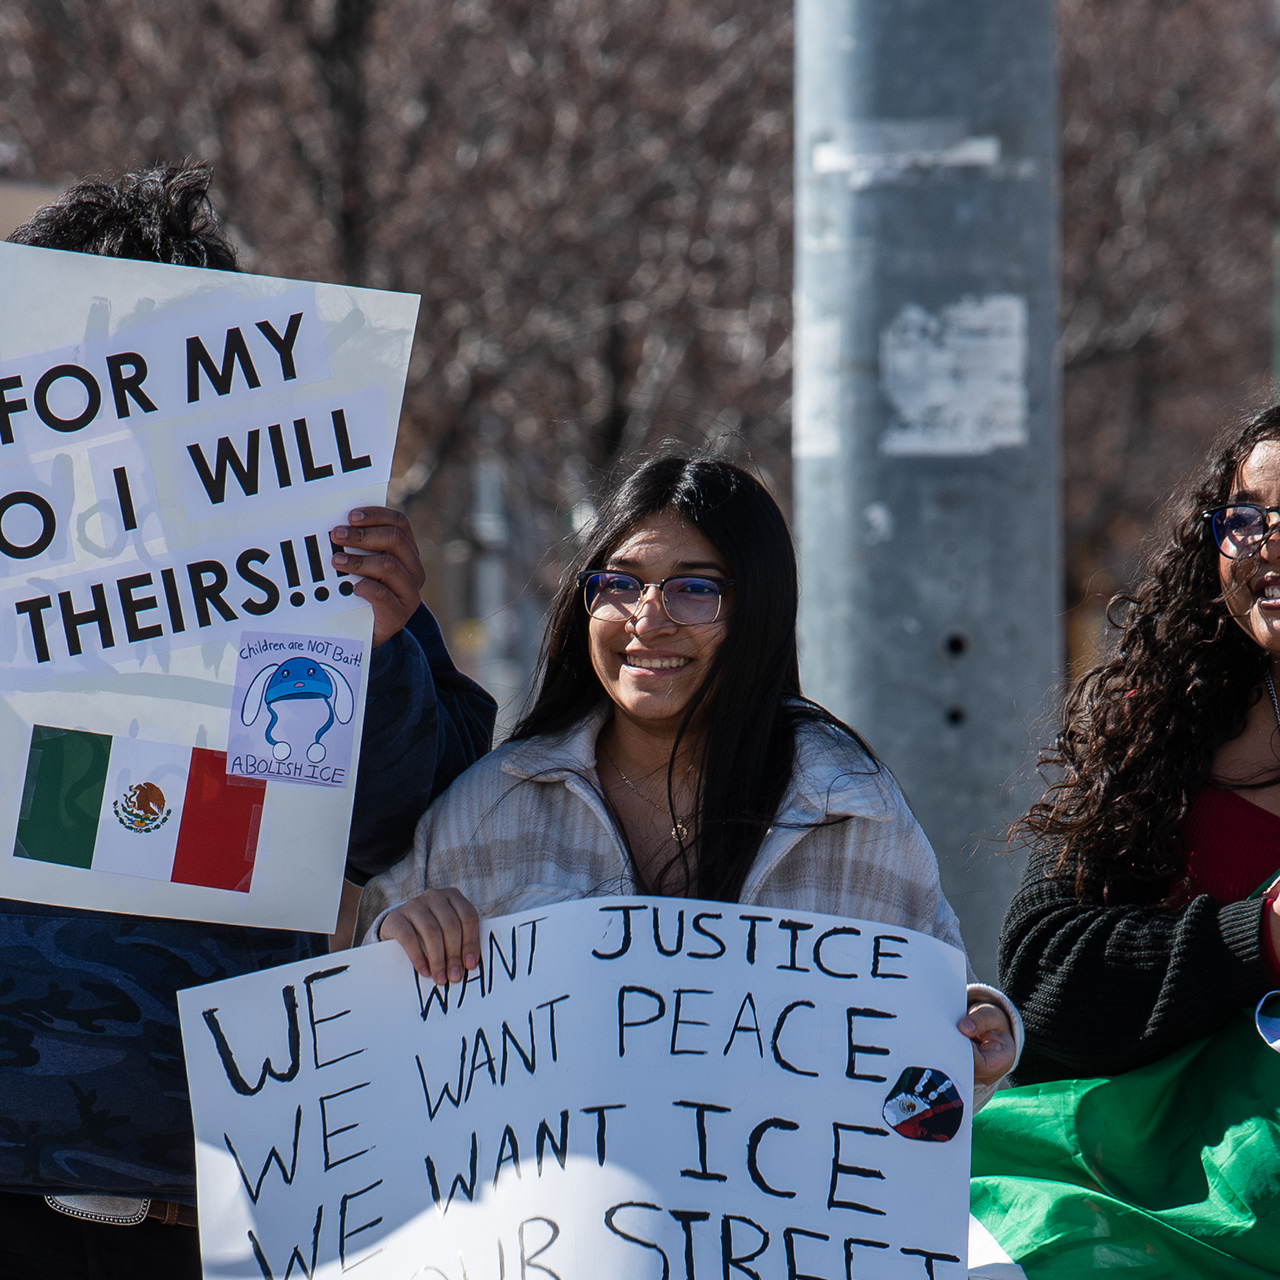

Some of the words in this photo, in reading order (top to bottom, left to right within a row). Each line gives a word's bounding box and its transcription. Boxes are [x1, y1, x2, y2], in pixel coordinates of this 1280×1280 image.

[186, 312, 304, 404] MY
[112, 466, 138, 532] I
[186, 408, 372, 505] WILL
[288, 641, 305, 651] are
[307, 640, 333, 656] NOT
[332, 645, 363, 667] Bait!
[231, 754, 304, 777] ABOLISH
[304, 764, 346, 784] ICE
[202, 964, 371, 1096] WE
[591, 904, 909, 980] JUSTICE
[223, 1081, 376, 1206] WE
[415, 994, 571, 1122] WANT
[618, 985, 898, 1084] PEACE
[424, 1103, 627, 1218] WANT
[671, 1099, 891, 1217] ICE
